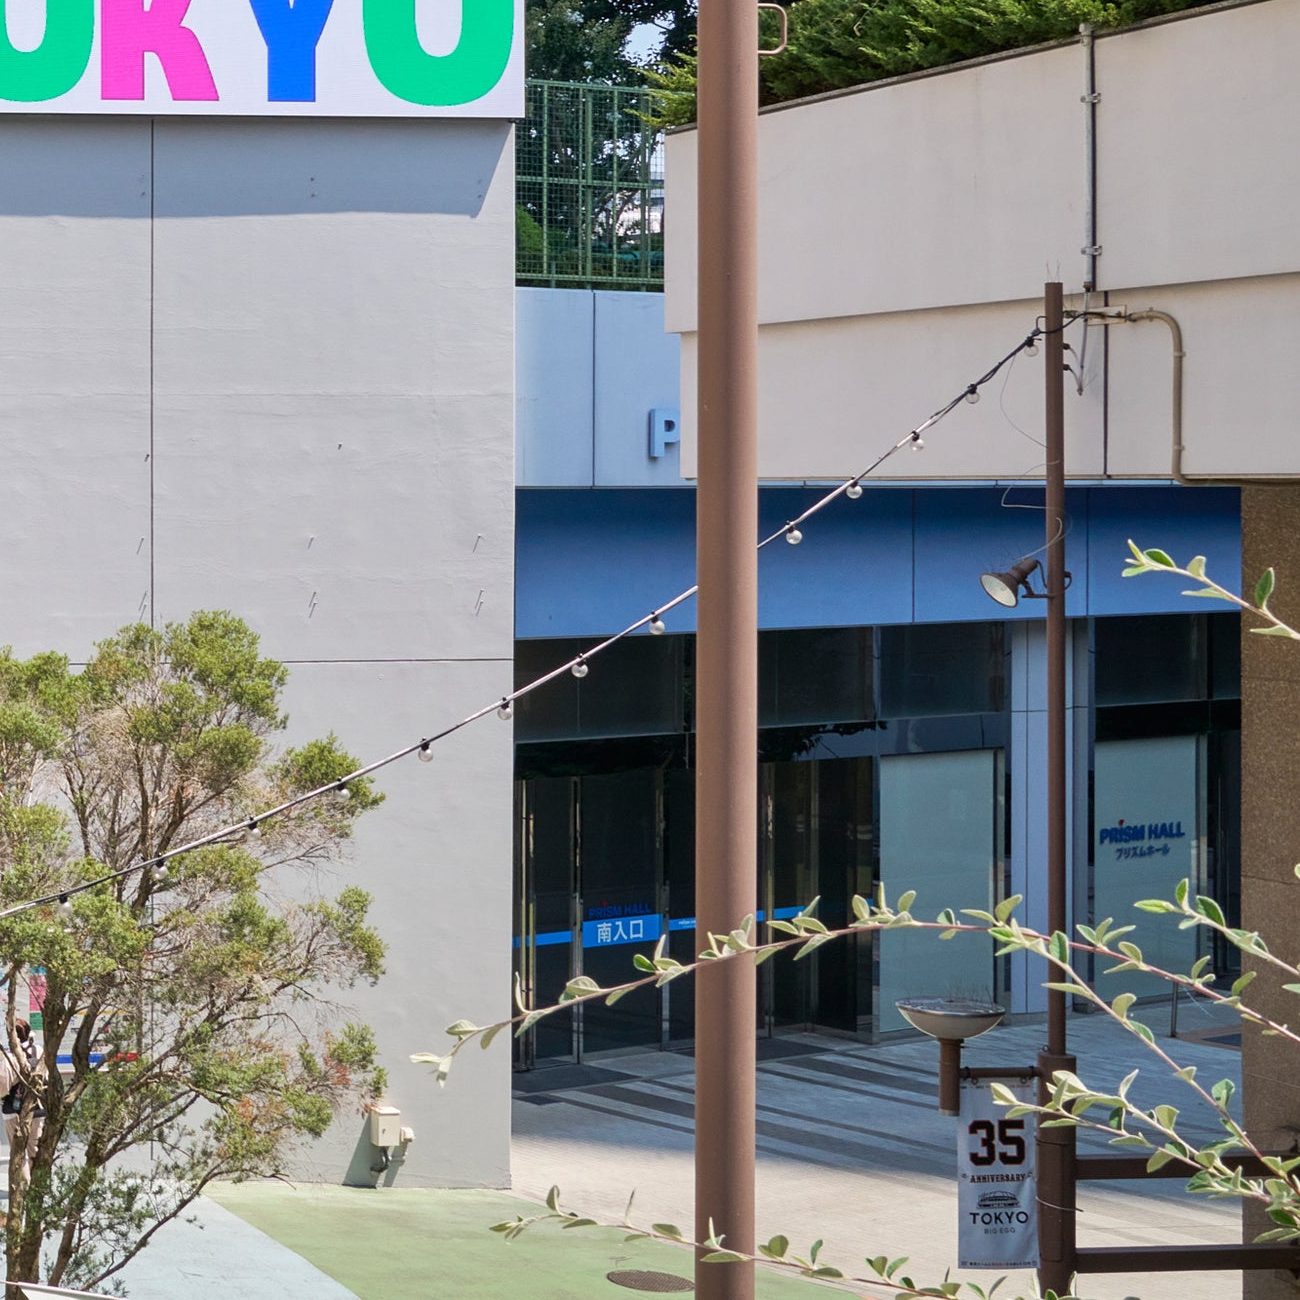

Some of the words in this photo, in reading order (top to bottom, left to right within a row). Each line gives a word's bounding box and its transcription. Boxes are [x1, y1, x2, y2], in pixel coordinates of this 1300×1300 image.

[1148, 821, 1185, 840] HALL
[624, 903, 652, 916] HALL
[597, 919, 644, 943] 南入口
[968, 1119, 1026, 1167] 35
[970, 1172, 1026, 1184] ANNIVERSARY
[969, 1211, 1029, 1225] TOKYO
[984, 1227, 998, 1235] BIG
